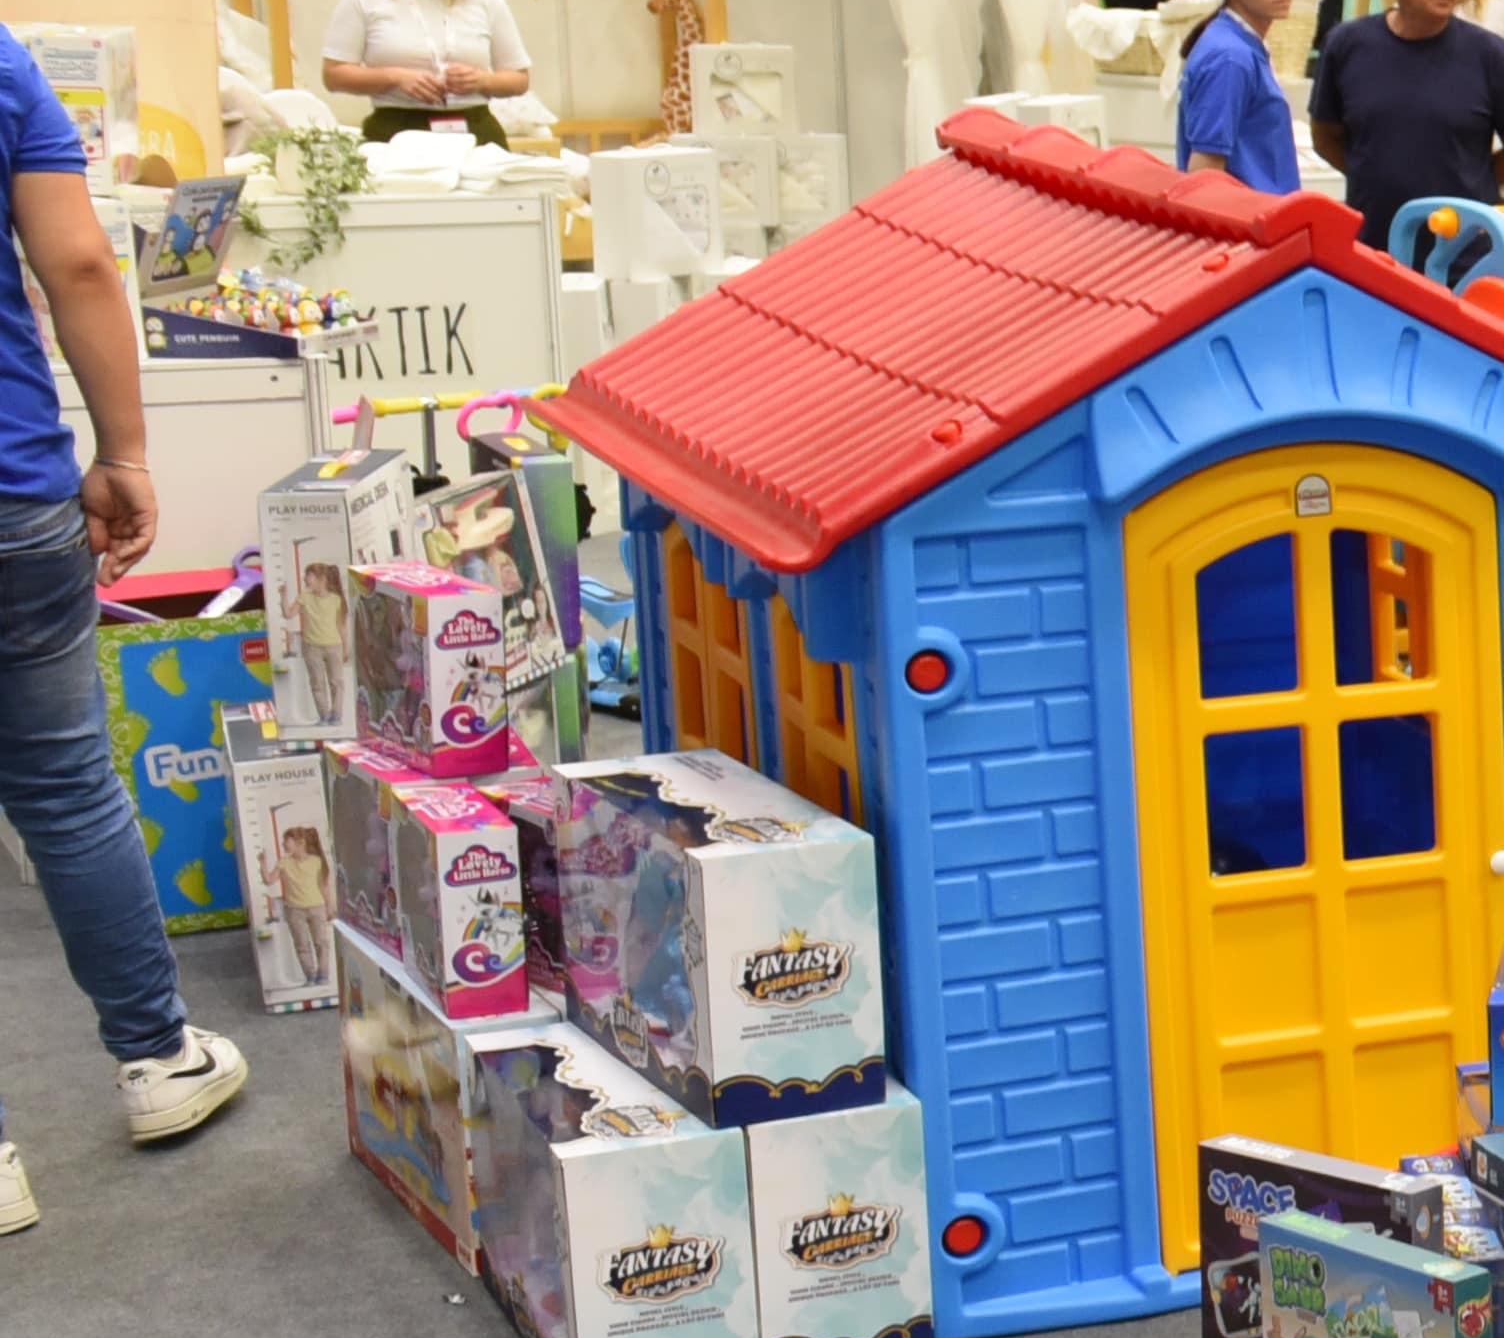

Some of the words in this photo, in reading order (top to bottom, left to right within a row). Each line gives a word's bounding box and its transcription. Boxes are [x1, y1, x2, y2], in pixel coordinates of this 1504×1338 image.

[267, 505, 296, 516] PLAY
[300, 504, 342, 515] HOUSE
[242, 772, 272, 784] PLAY
[275, 767, 317, 781] HOUSE
[738, 943, 852, 989] FANTASY
[1208, 1169, 1296, 1214] SPACE
[784, 1208, 898, 1253] FANTASY
[602, 1238, 722, 1283] FANTASY
